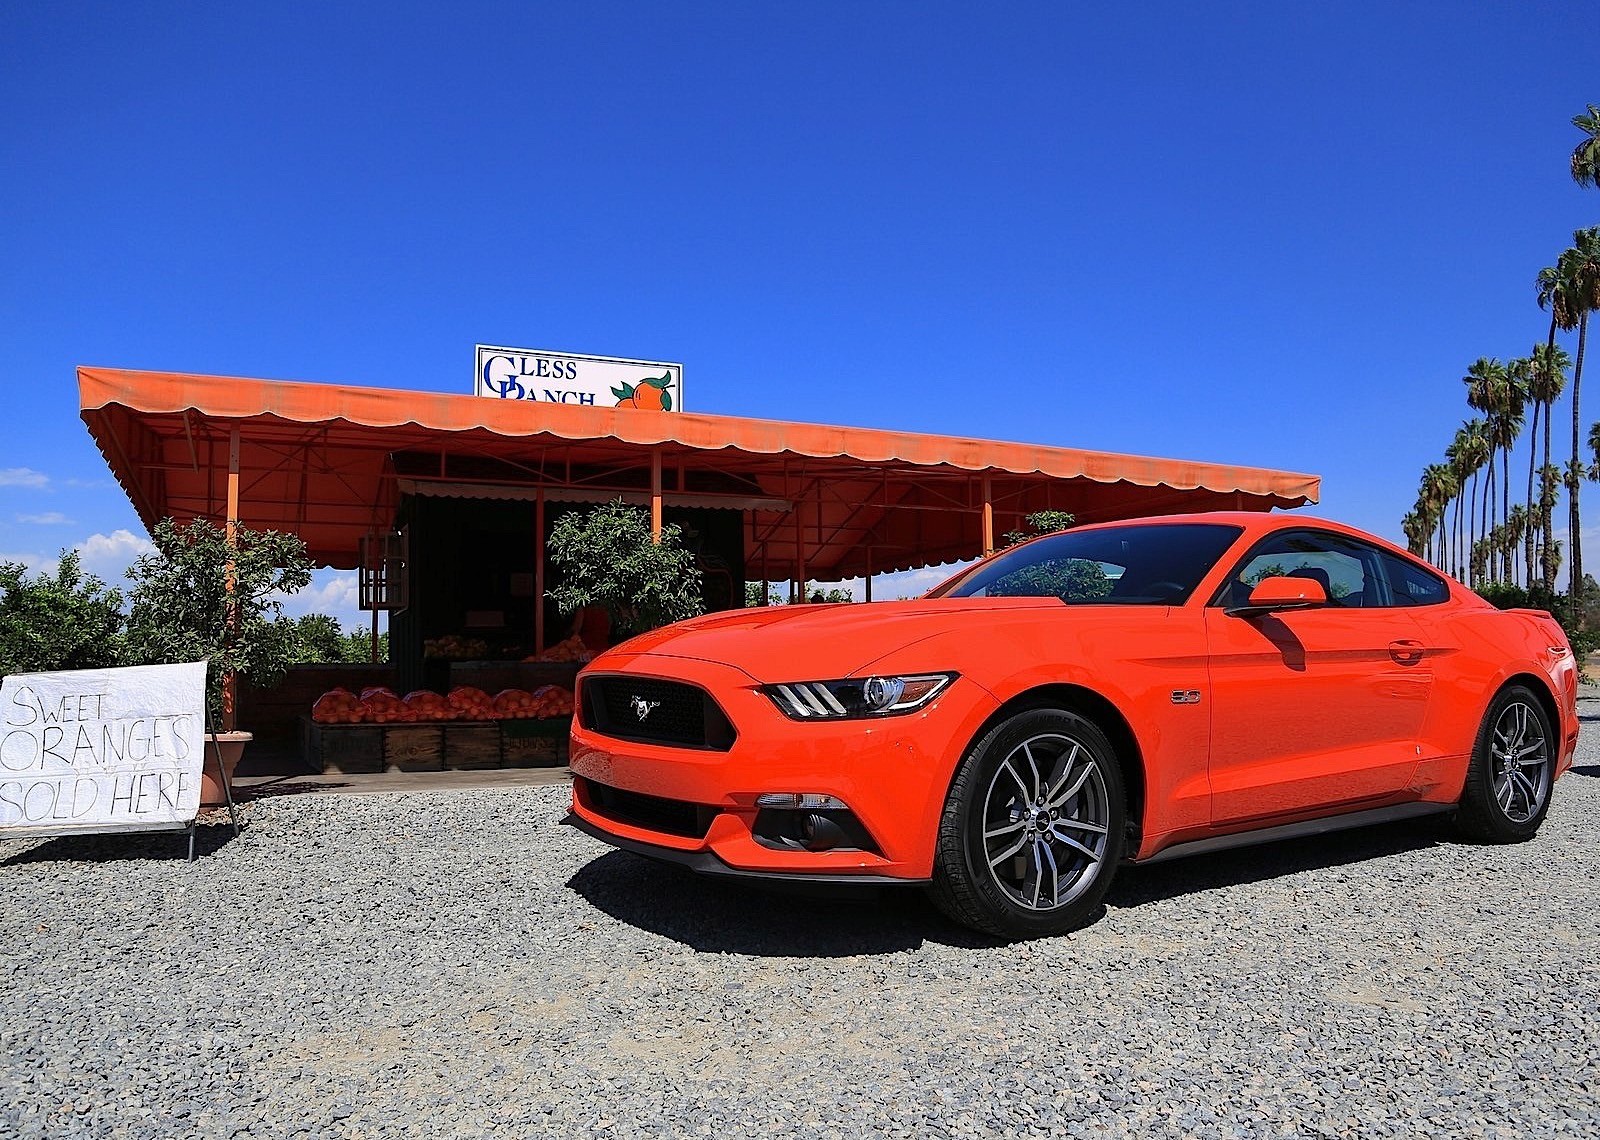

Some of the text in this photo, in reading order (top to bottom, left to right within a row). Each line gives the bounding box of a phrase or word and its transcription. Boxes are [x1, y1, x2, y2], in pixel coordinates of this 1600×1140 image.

[483, 355, 577, 393] GLESS
[6, 686, 107, 727] SWEET
[0, 716, 190, 771] ORANGES
[0, 772, 189, 827] SOLD HERE
